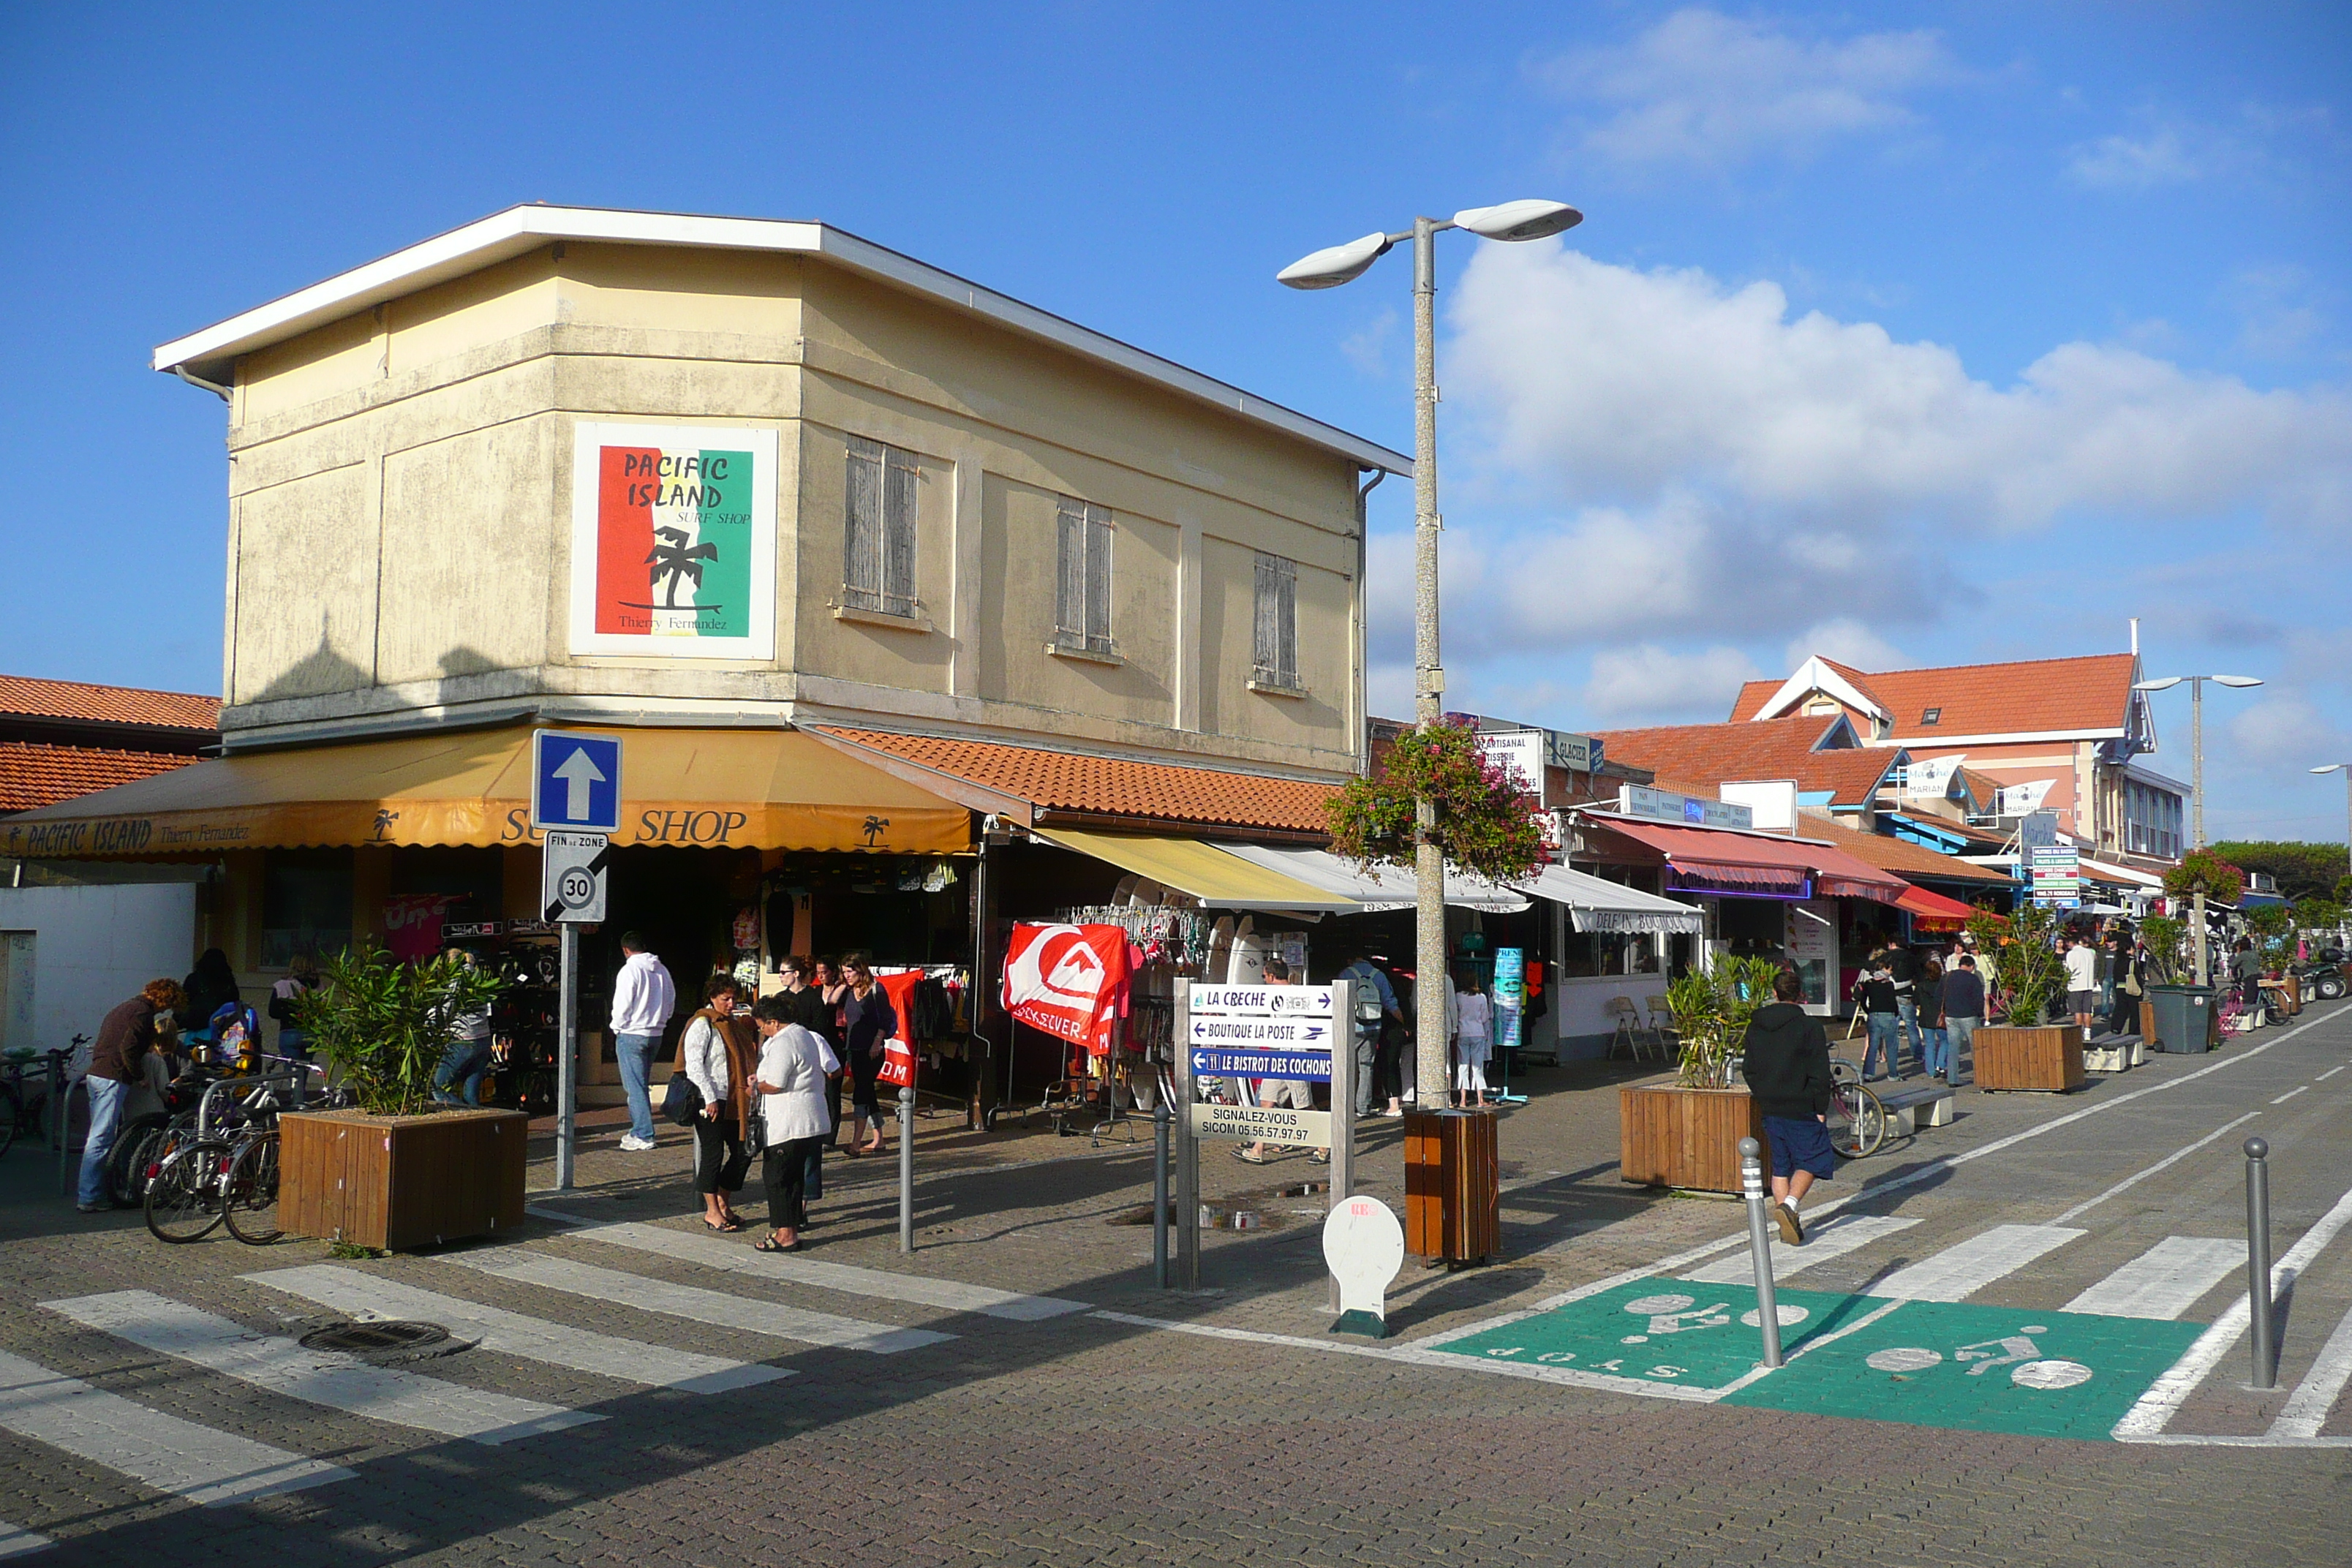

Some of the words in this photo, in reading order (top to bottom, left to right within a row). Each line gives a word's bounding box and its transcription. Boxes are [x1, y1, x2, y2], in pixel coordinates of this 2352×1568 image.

[625, 453, 728, 480] PACIFIC
[628, 483, 722, 508] ISLAND
[676, 511, 712, 524] SURF
[717, 513, 751, 524] SHOP
[619, 615, 662, 631] Thierry
[669, 617, 727, 630] Fernandez
[1559, 742, 1586, 761] GLACIER
[1910, 785, 1944, 794] MARIAN
[635, 810, 747, 843] SHOP
[27, 822, 88, 853] PACIFIC
[93, 819, 151, 851] ISLAND
[161, 826, 193, 845] Thierry
[197, 822, 250, 841] Fernandez
[551, 836, 568, 846] FIN
[578, 837, 604, 848] ZONE
[565, 879, 589, 897] 30
[1597, 913, 1632, 929] DELF'IN
[1638, 914, 1684, 930] BOUTIQUE
[1207, 992, 1219, 1005] LA
[1208, 1023, 1252, 1038] BOUTIQUE
[1254, 1025, 1264, 1039] LA
[1267, 1026, 1294, 1040] POSTE
[1222, 1055, 1232, 1070] LE
[1233, 1056, 1269, 1072] BISTROT
[1270, 1058, 1287, 1073] DES
[1289, 1059, 1331, 1075] COCHONS
[1213, 1108, 1297, 1126] SIGNALEZ-VOUS
[1202, 1121, 1236, 1134] SICOM
[1238, 1124, 1308, 1141] 05.56.57.97.97
[1486, 1347, 1688, 1378] STOP
